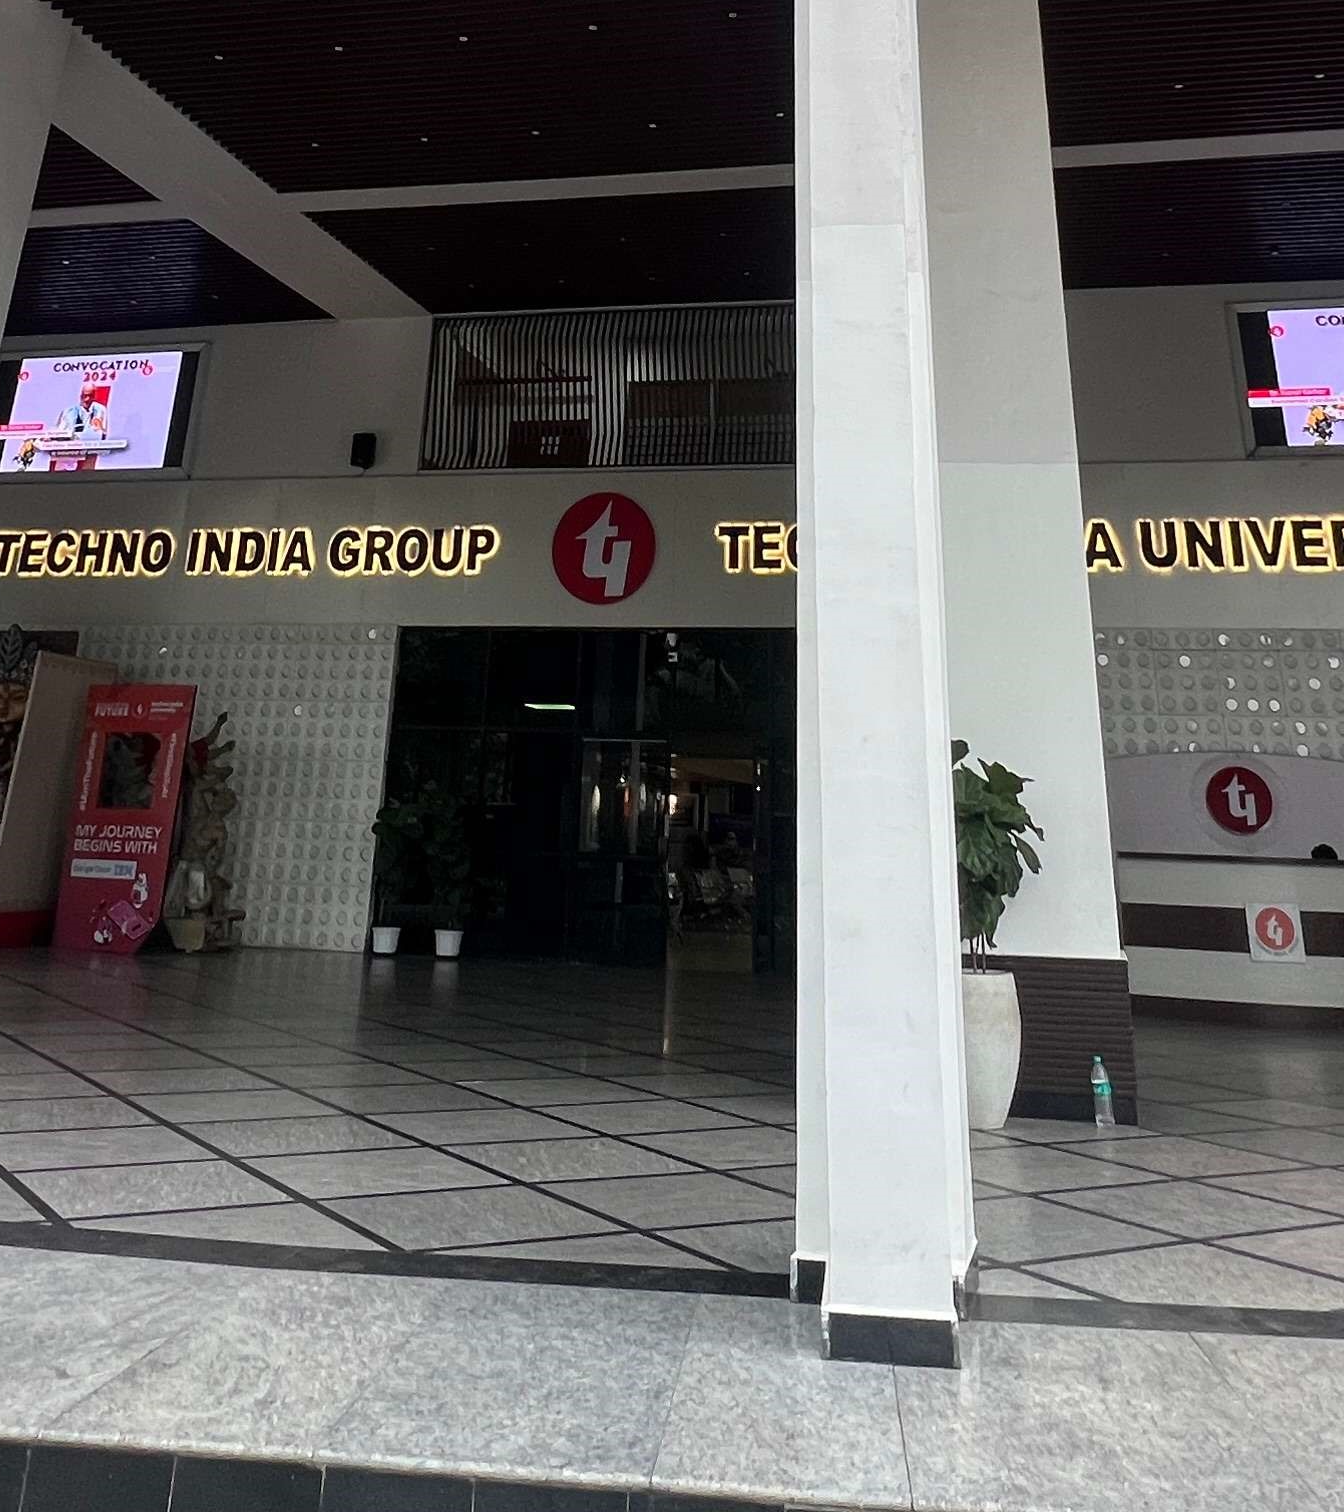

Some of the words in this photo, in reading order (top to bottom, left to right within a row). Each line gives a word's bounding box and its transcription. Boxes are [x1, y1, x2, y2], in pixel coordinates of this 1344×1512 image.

[53, 359, 149, 373] CONVOCATION
[82, 370, 117, 382] 2024
[185, 528, 314, 574] INDIA
[327, 526, 499, 575] GROUP
[75, 824, 97, 837] MY
[99, 824, 162, 840] JOURNEY
[73, 838, 122, 853] BEGINS
[124, 840, 159, 854] WITH
